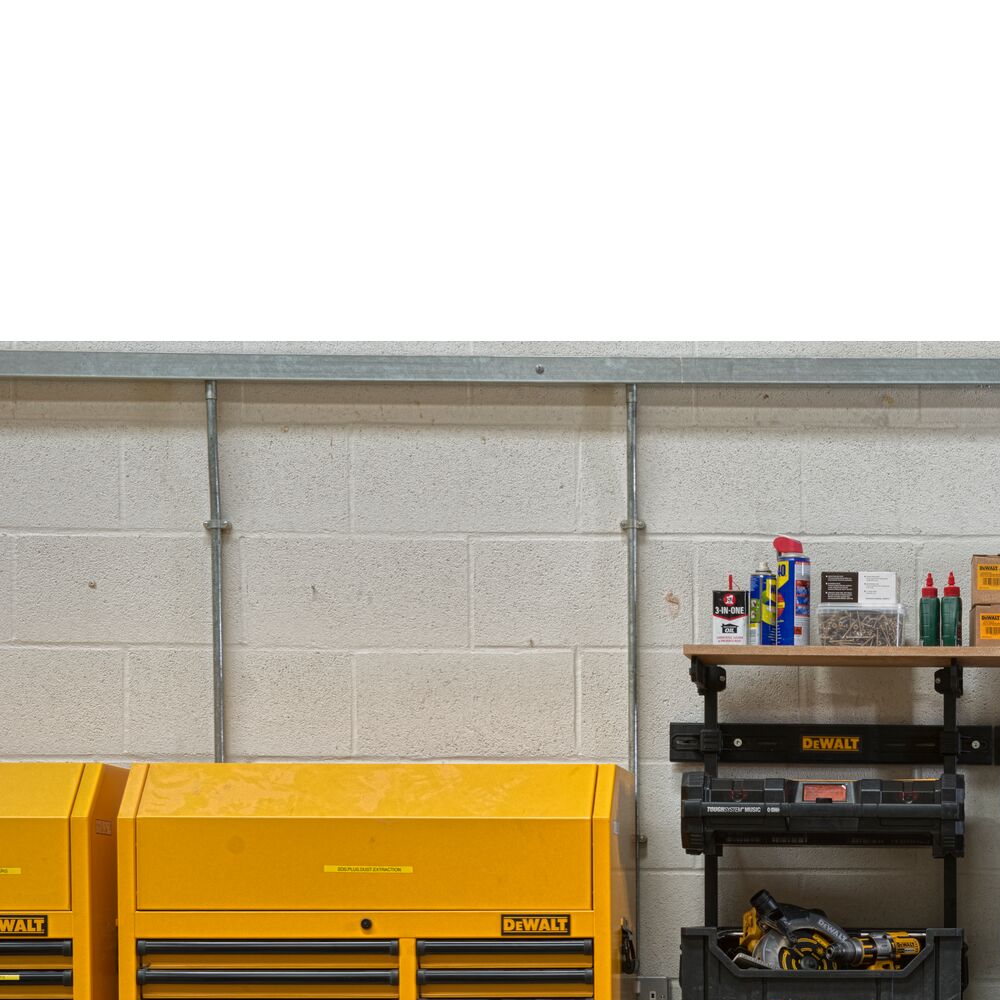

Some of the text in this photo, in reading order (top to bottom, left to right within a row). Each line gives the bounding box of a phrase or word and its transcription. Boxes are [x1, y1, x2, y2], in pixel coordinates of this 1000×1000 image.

[803, 737, 859, 750] DEWALT
[504, 918, 568, 931] DEWALT
[818, 919, 848, 942] DEWALT
